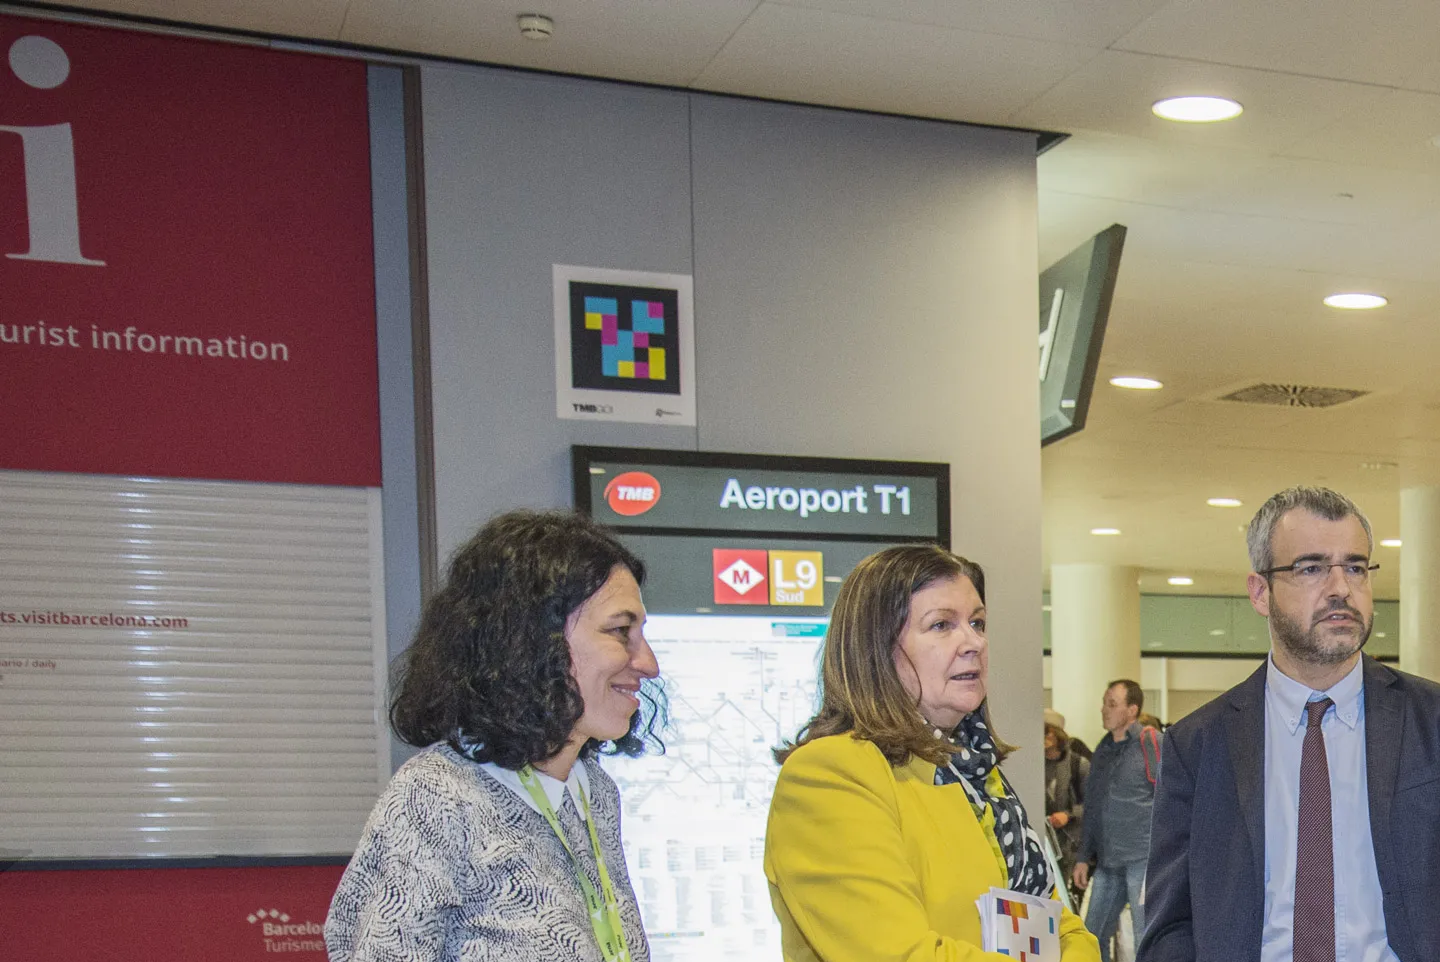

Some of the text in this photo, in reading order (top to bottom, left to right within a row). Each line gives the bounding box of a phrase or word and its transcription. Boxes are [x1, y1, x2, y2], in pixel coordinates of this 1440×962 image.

[92, 325, 289, 361] information
[617, 485, 654, 501] TMB
[719, 479, 910, 517] Aeroport T1
[732, 570, 750, 585] M
[774, 559, 817, 590] L9
[775, 590, 804, 604] Sud
[0, 610, 188, 628] ts.visitbarcelona.com
[263, 938, 324, 952] Turisme
